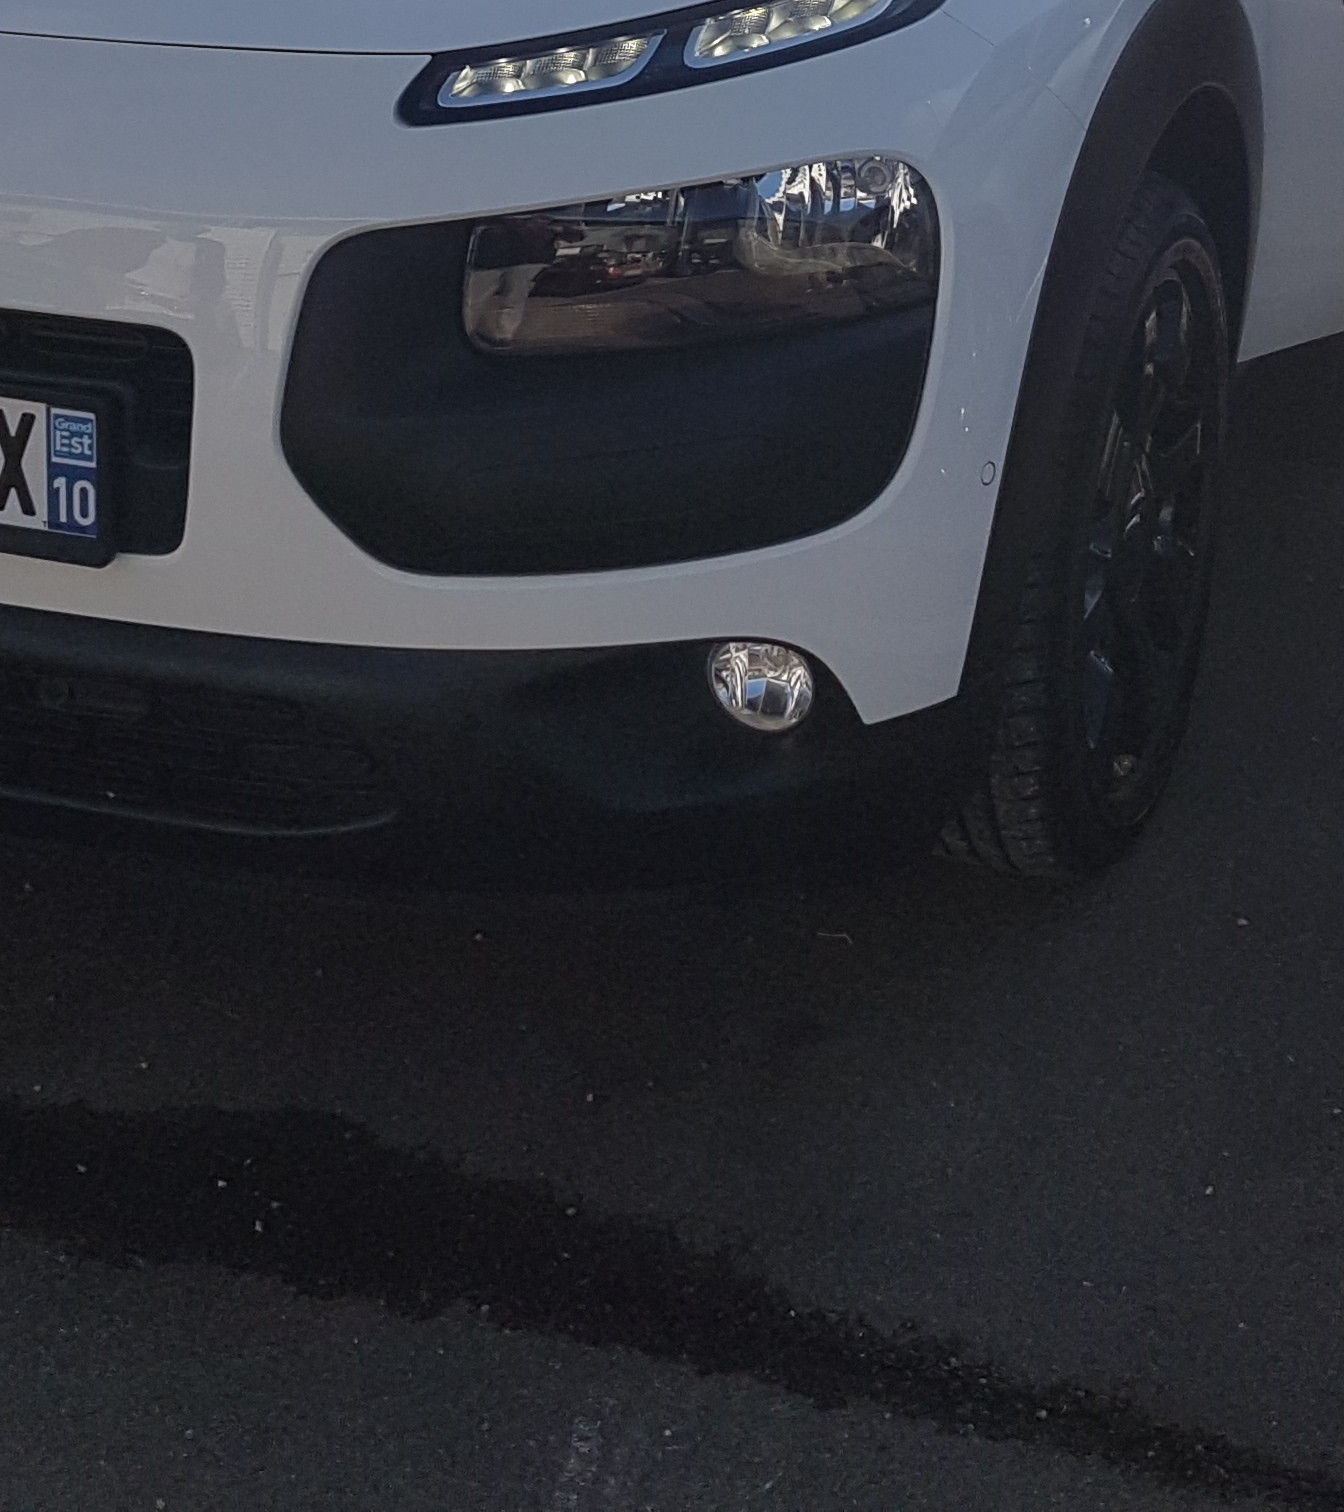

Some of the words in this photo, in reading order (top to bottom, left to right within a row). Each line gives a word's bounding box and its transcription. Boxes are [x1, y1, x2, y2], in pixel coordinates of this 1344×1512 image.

[55, 417, 93, 434] Grand
[55, 430, 93, 456] Est
[52, 476, 96, 526] 10
